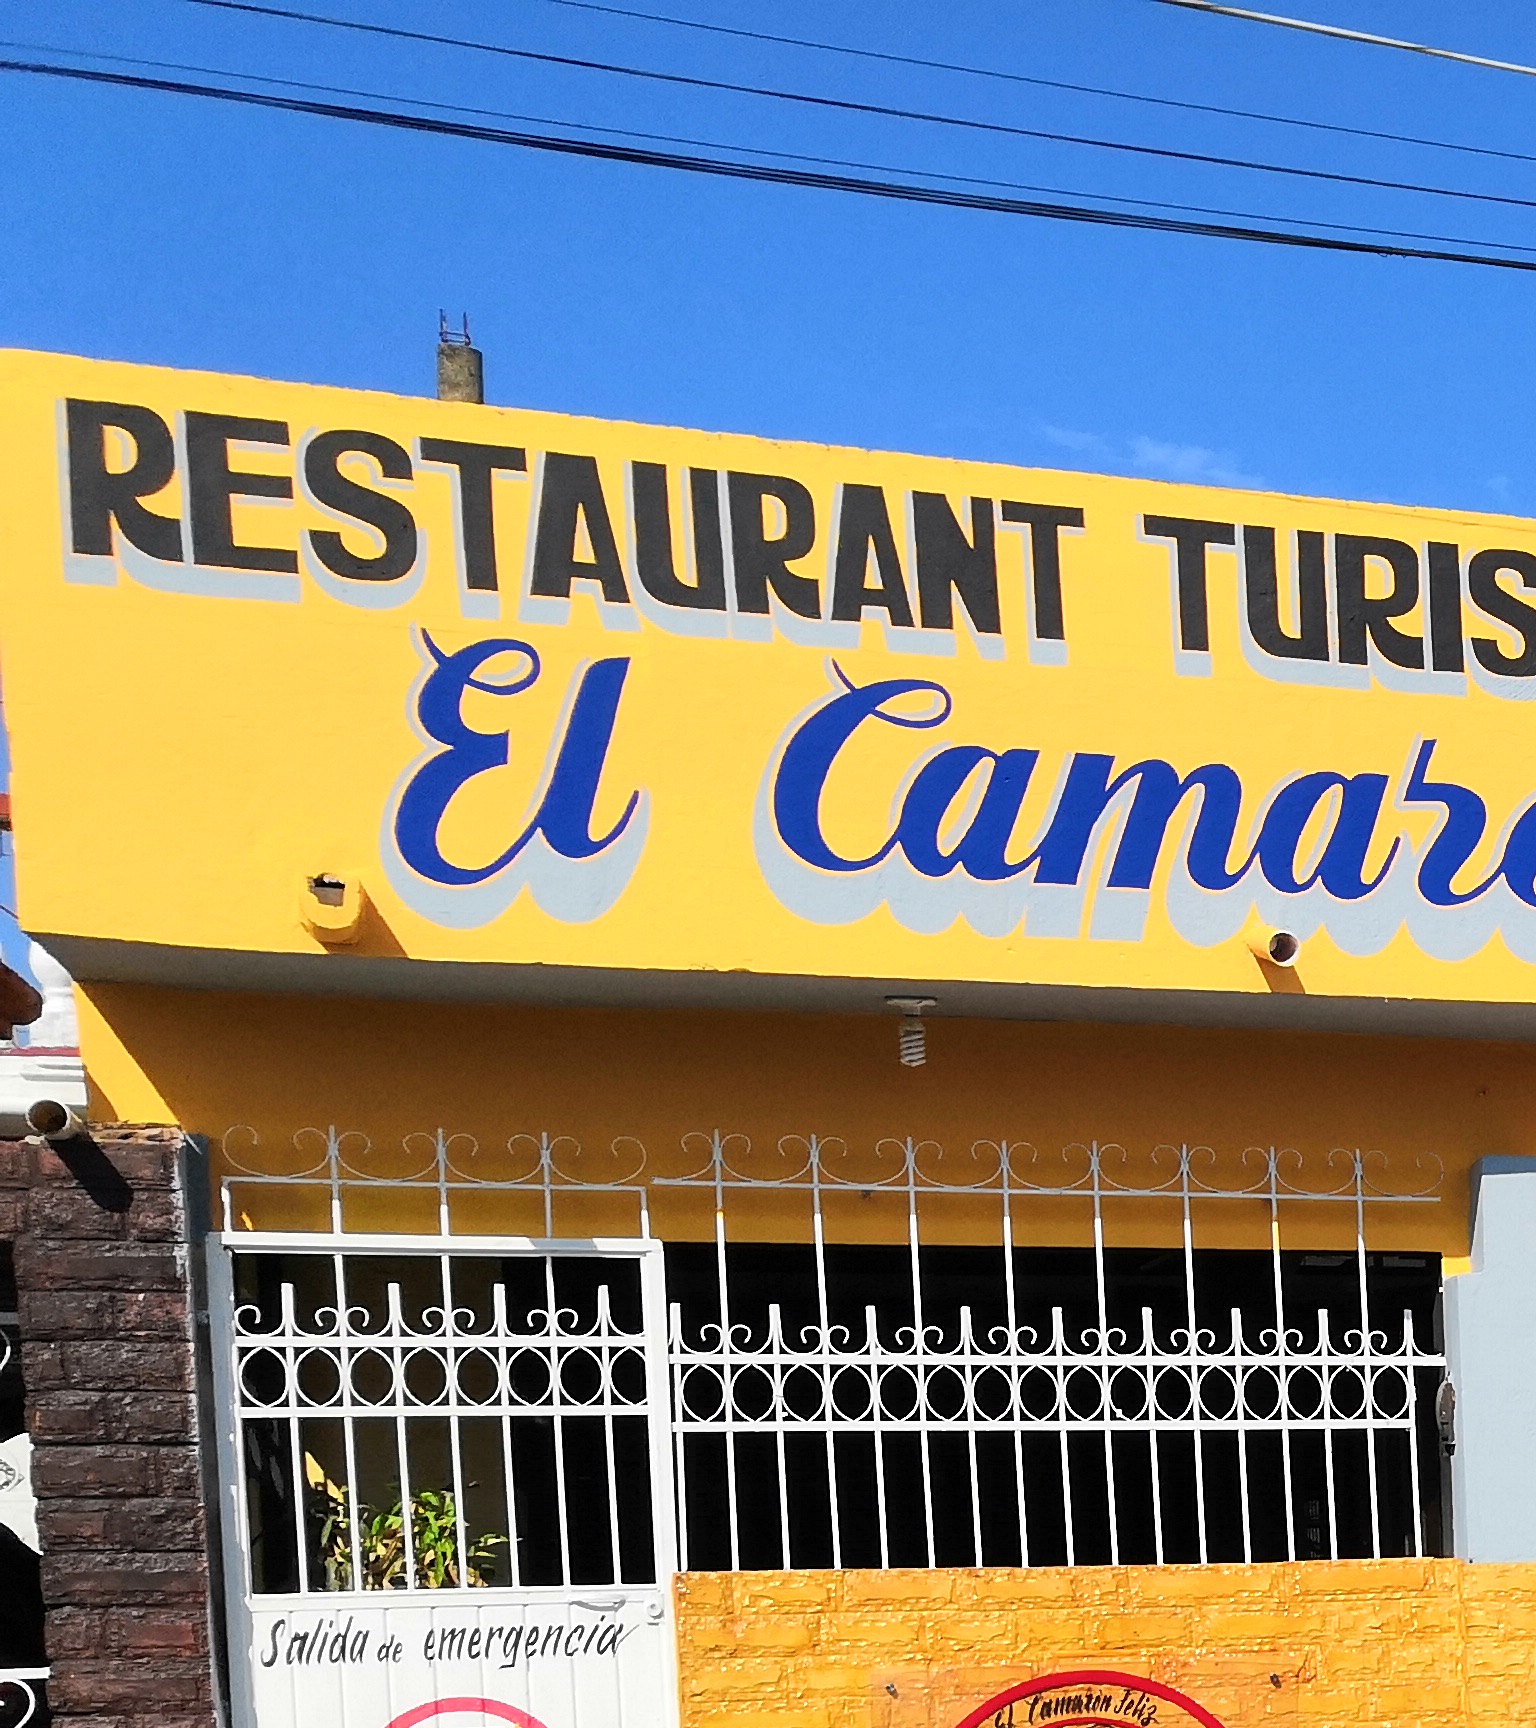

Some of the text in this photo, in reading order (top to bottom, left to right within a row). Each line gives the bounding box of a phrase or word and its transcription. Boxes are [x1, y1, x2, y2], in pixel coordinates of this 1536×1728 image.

[62, 398, 1085, 652] RESTAURANT
[392, 626, 642, 890] El
[260, 1614, 630, 1671] Salida de emergencia
